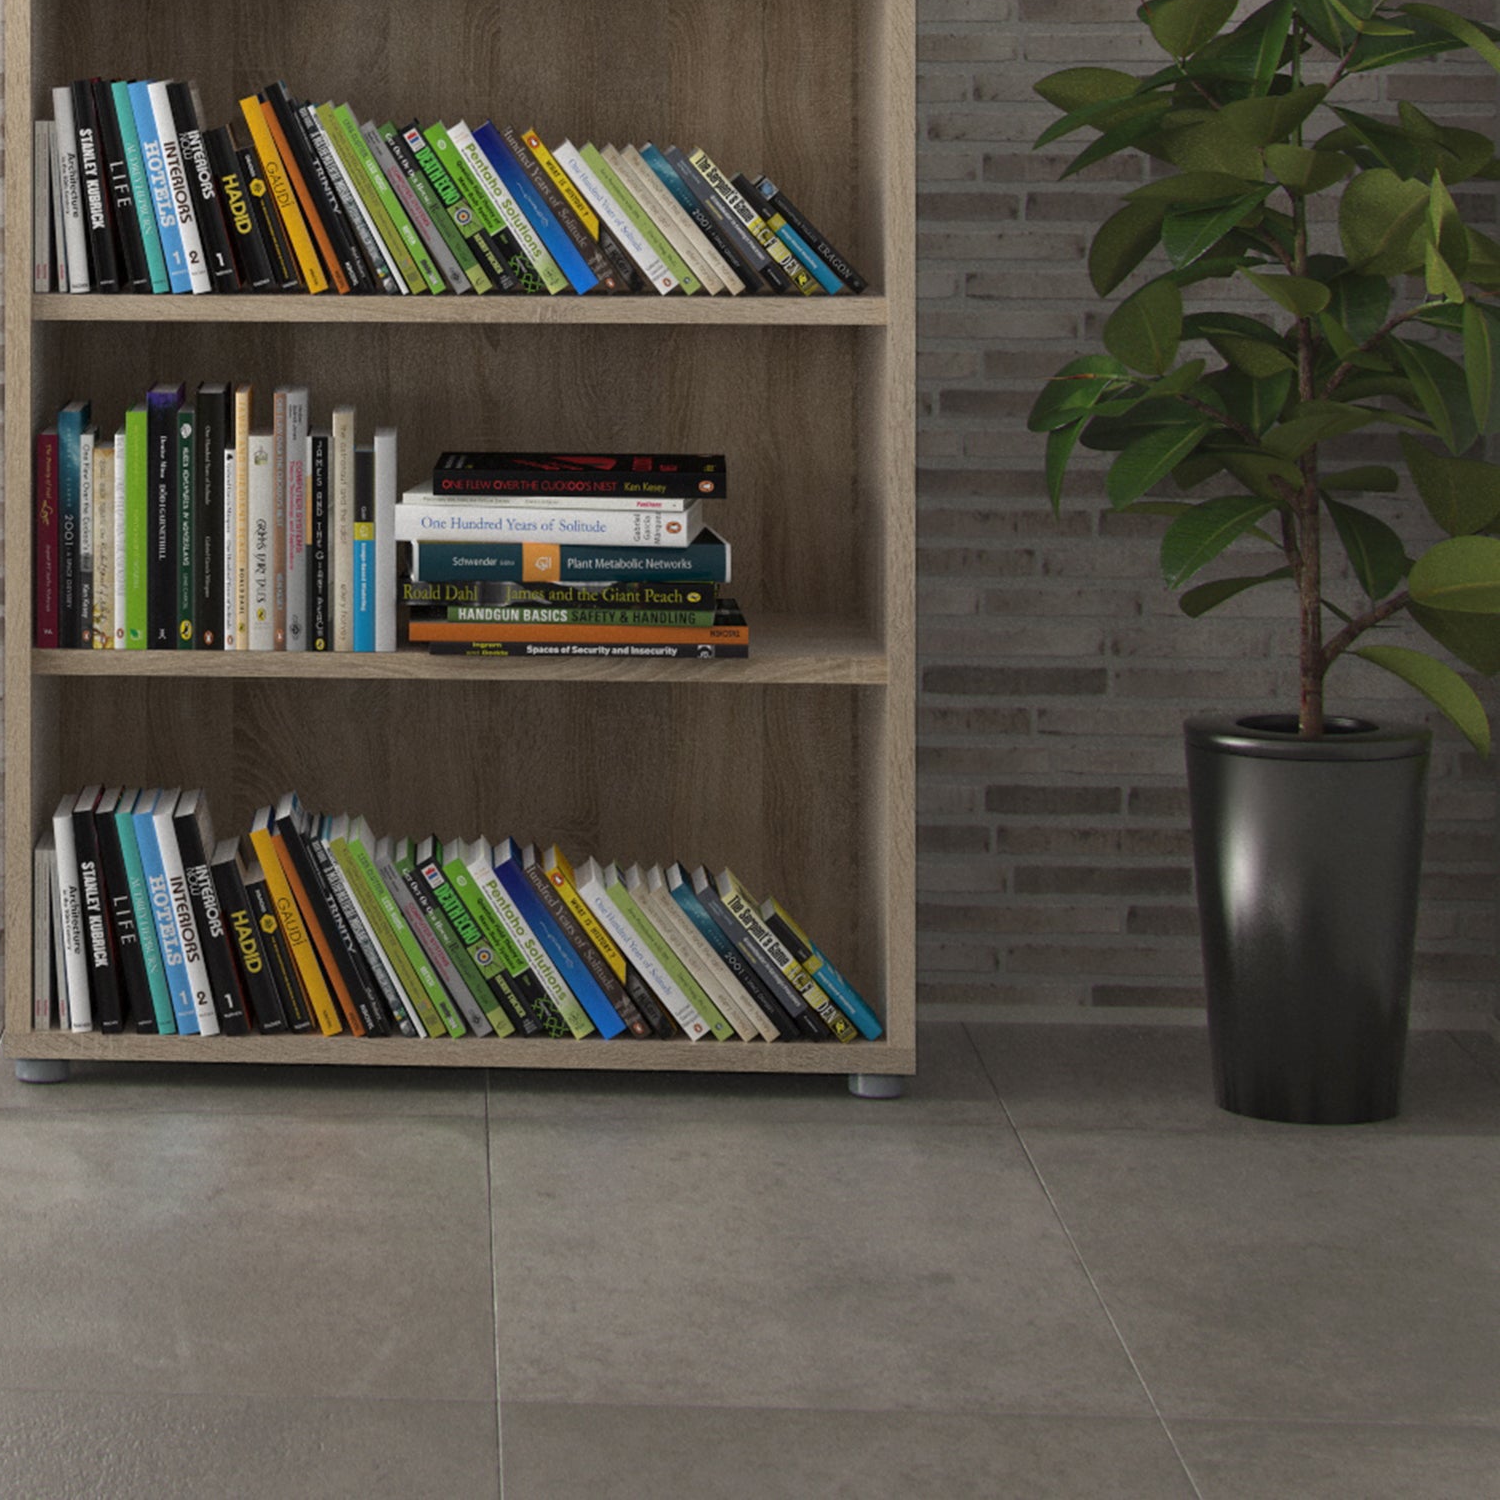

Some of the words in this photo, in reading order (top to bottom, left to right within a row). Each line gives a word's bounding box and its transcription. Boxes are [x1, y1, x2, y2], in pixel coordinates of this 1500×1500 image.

[79, 128, 96, 176] STANLEY
[187, 129, 214, 199] INTERIORS
[415, 146, 445, 180] DEATH
[433, 176, 460, 205] ECHO
[86, 179, 104, 228] KUBRICK
[109, 161, 131, 207] LIFE
[144, 140, 174, 227] HOTELS
[164, 141, 191, 223] INTERIORS
[222, 173, 252, 234] HADID
[464, 142, 505, 197] Pentaho
[500, 197, 544, 257] Solutions
[529, 167, 552, 195] Years
[547, 193, 562, 209] of
[557, 207, 590, 248] Solitude
[173, 251, 179, 264] 1
[189, 250, 198, 264] 2
[216, 253, 224, 266] 1
[442, 479, 464, 489] ONE
[465, 480, 491, 490] FLEW
[493, 479, 519, 490] OVER
[520, 480, 539, 490] THE
[593, 481, 618, 491] NEST
[623, 482, 641, 492] Ken
[643, 482, 666, 494] Kesey
[421, 516, 447, 529] One
[450, 517, 503, 531] Hundred
[506, 518, 537, 531] Years
[541, 518, 555, 531] of
[558, 520, 607, 533] Solitude
[452, 557, 497, 566] Schwender
[567, 558, 593, 570] Plant
[595, 558, 644, 569] Metabolic
[645, 559, 693, 570] Networks
[403, 584, 441, 600] Roald
[445, 584, 478, 601] Dahl
[458, 608, 520, 621] HANDGUN
[523, 609, 568, 622] BASICS
[571, 610, 616, 622] SAFETY
[633, 611, 696, 625] HANDLING
[506, 586, 545, 603] James
[548, 587, 573, 601] and
[577, 589, 598, 601] the
[601, 588, 641, 603] Giant
[644, 589, 683, 603] Peach
[526, 645, 560, 655] Spaces
[561, 646, 571, 654] of
[571, 645, 610, 655] Security
[611, 646, 630, 655] and
[630, 646, 678, 657] Insecurity
[80, 861, 99, 911] STANLEY
[195, 864, 223, 937] INTERIORS
[113, 896, 135, 944] LIFE
[149, 874, 181, 965] HOTELS
[170, 877, 199, 962] INTERIORS
[432, 882, 464, 919] DEATH
[453, 913, 482, 945] ECHO
[88, 915, 107, 967] KUBRICK
[231, 910, 262, 973] HADID
[485, 879, 527, 936] Pentaho
[523, 938, 568, 1000] Solutions
[554, 906, 578, 934] Years
[573, 934, 588, 949] of
[583, 948, 617, 992] Solitude
[179, 991, 187, 1004] 1
[197, 992, 206, 1004] 2
[224, 994, 233, 1008] 1
